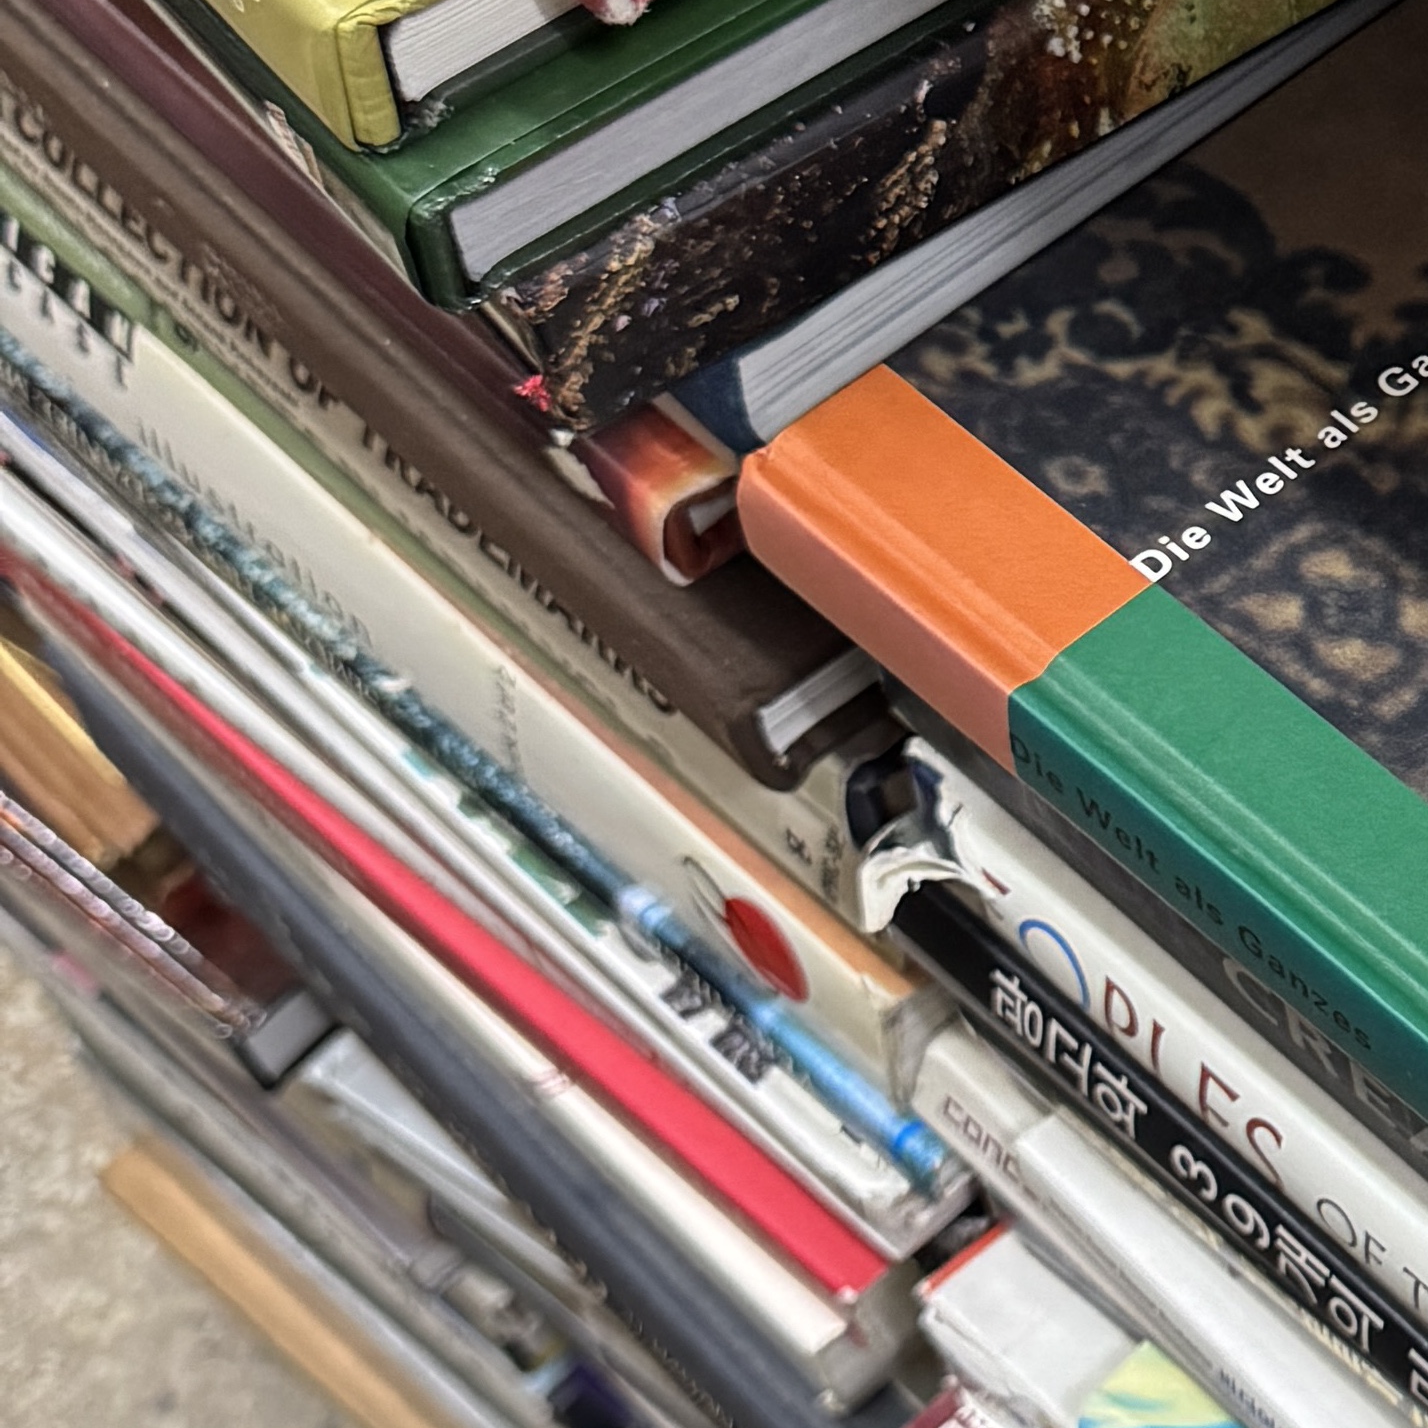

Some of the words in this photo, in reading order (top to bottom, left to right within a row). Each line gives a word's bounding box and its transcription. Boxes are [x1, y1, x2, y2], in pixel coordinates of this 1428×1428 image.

[1128, 523, 1211, 583] Die
[1205, 445, 1314, 523] Welt
[1317, 399, 1378, 449] als
[1011, 731, 1064, 801] Die
[1079, 794, 1160, 867] Welt
[1176, 872, 1223, 926] als
[1238, 925, 1373, 1052] Ganzes
[990, 968, 1148, 1139] 광고와
[1169, 1144, 1384, 1354] 39개의
[1316, 1196, 1387, 1266] OF
